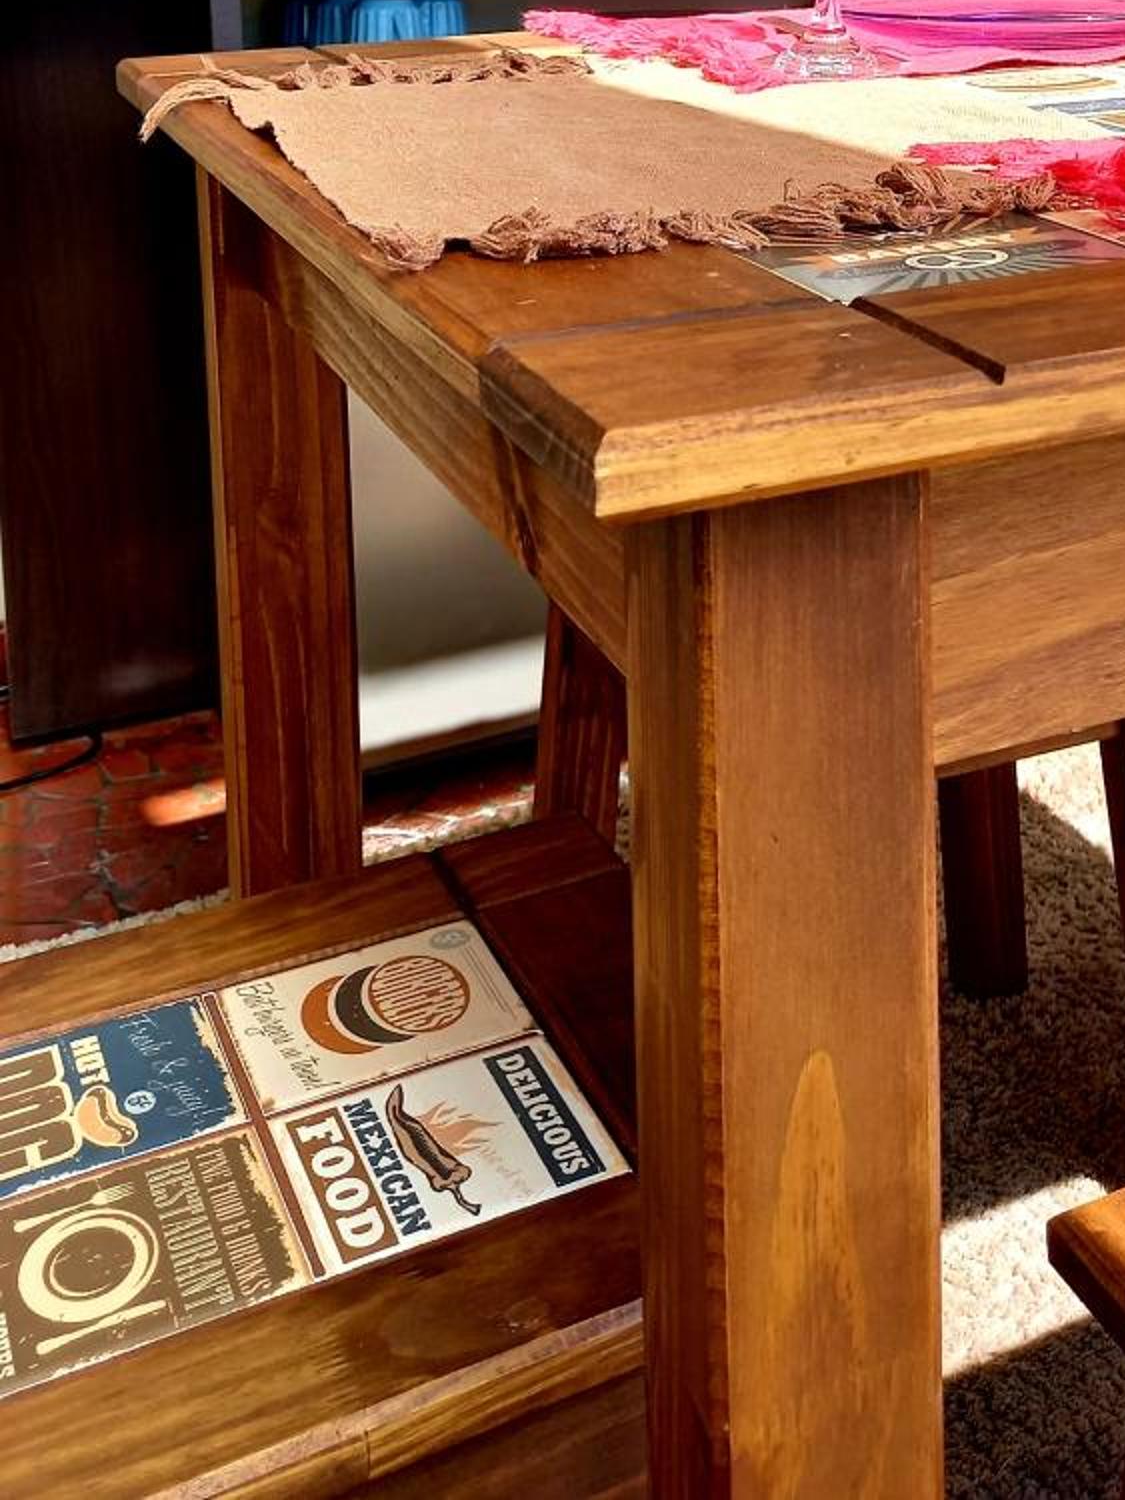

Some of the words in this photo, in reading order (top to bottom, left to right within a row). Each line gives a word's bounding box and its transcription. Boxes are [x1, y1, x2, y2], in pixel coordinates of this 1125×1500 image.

[372, 957, 465, 1032] BURGERS
[70, 1035, 111, 1085] HOT
[496, 1052, 590, 1175] DELICIOUS
[196, 1148, 232, 1183] FINE
[208, 1180, 247, 1221] FOOD
[296, 1116, 384, 1248] FOOD
[343, 1098, 432, 1236] MEXICAN
[145, 1158, 235, 1311] RESTAURANT
[225, 1233, 272, 1296] DRINKS
